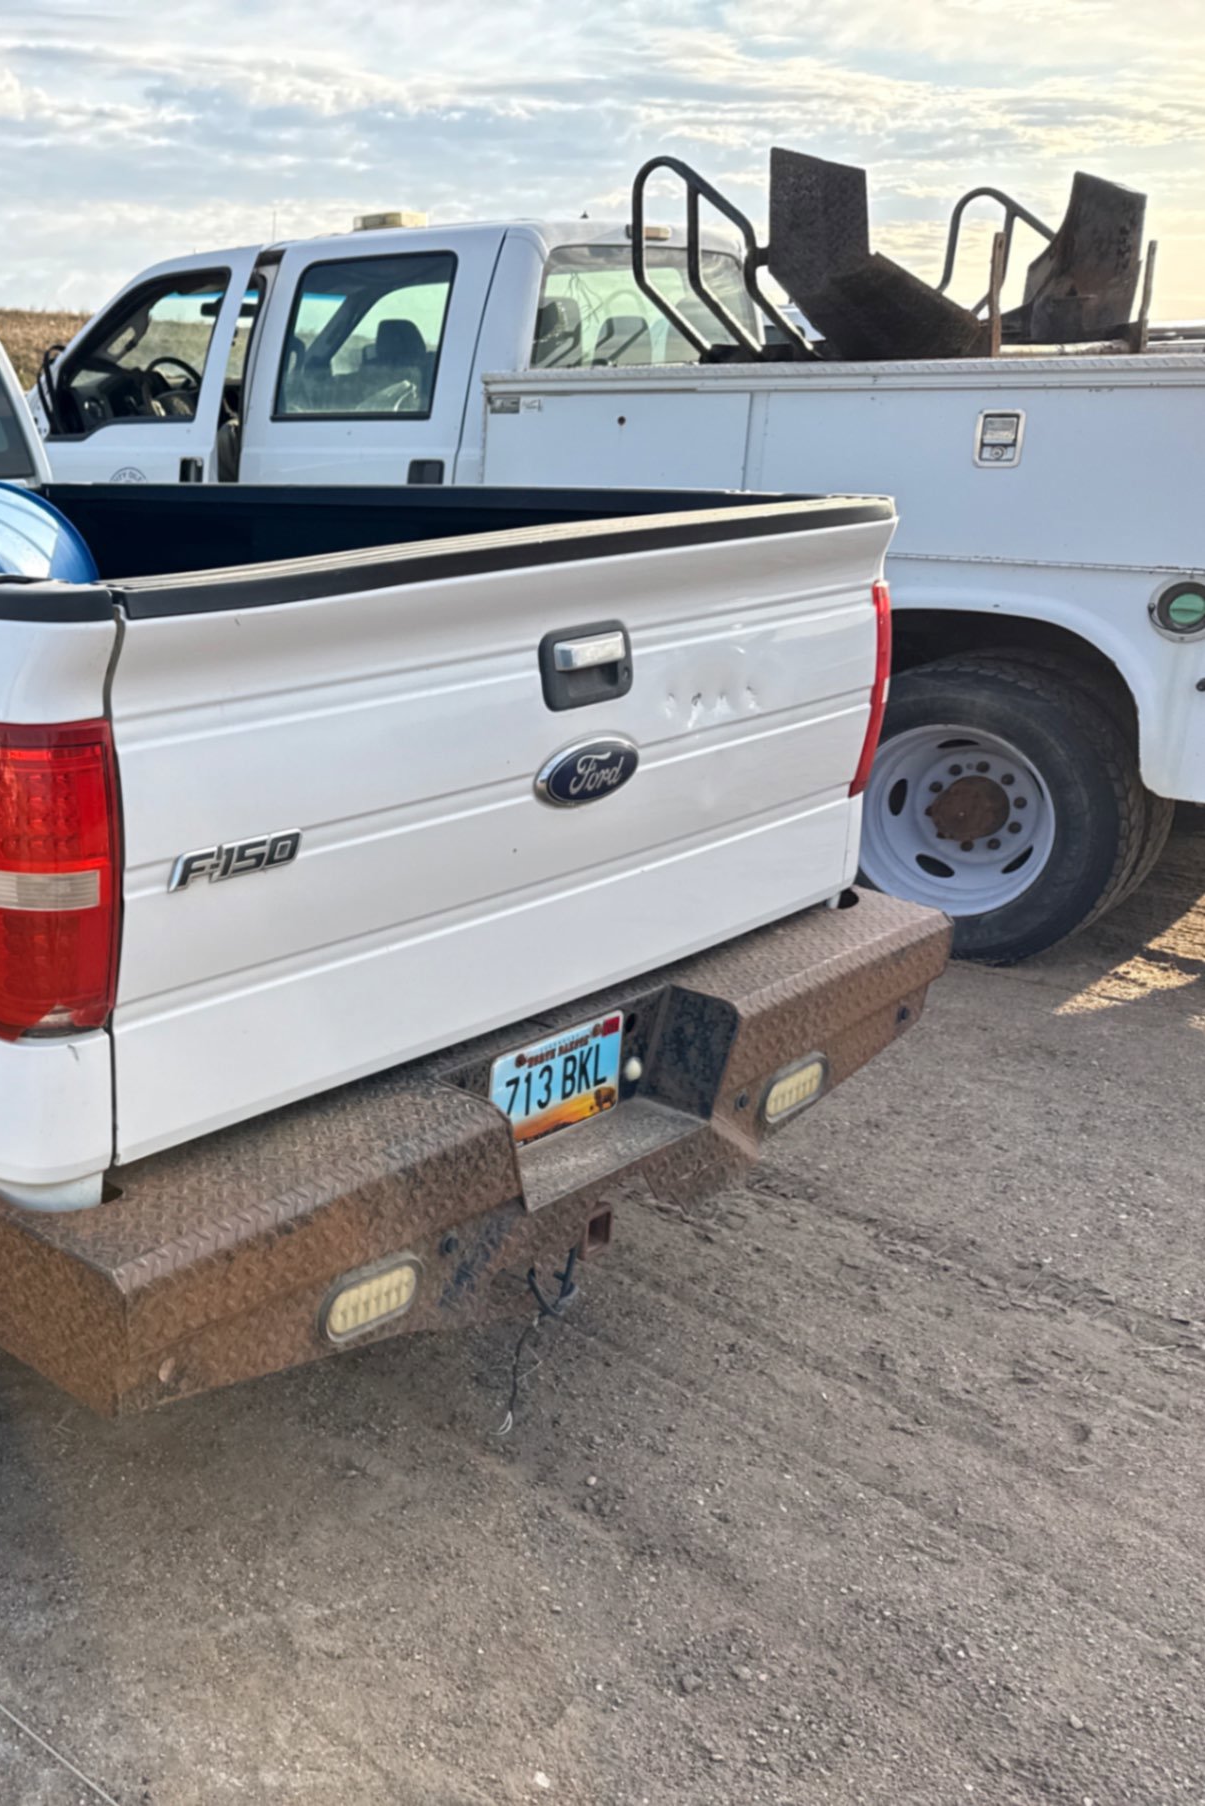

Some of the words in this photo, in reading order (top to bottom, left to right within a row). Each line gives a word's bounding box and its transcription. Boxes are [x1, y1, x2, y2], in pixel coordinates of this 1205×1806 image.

[569, 751, 624, 796] Ford
[167, 827, 303, 894] F-150
[505, 1064, 554, 1117] 713
[560, 1042, 607, 1101] BKL
